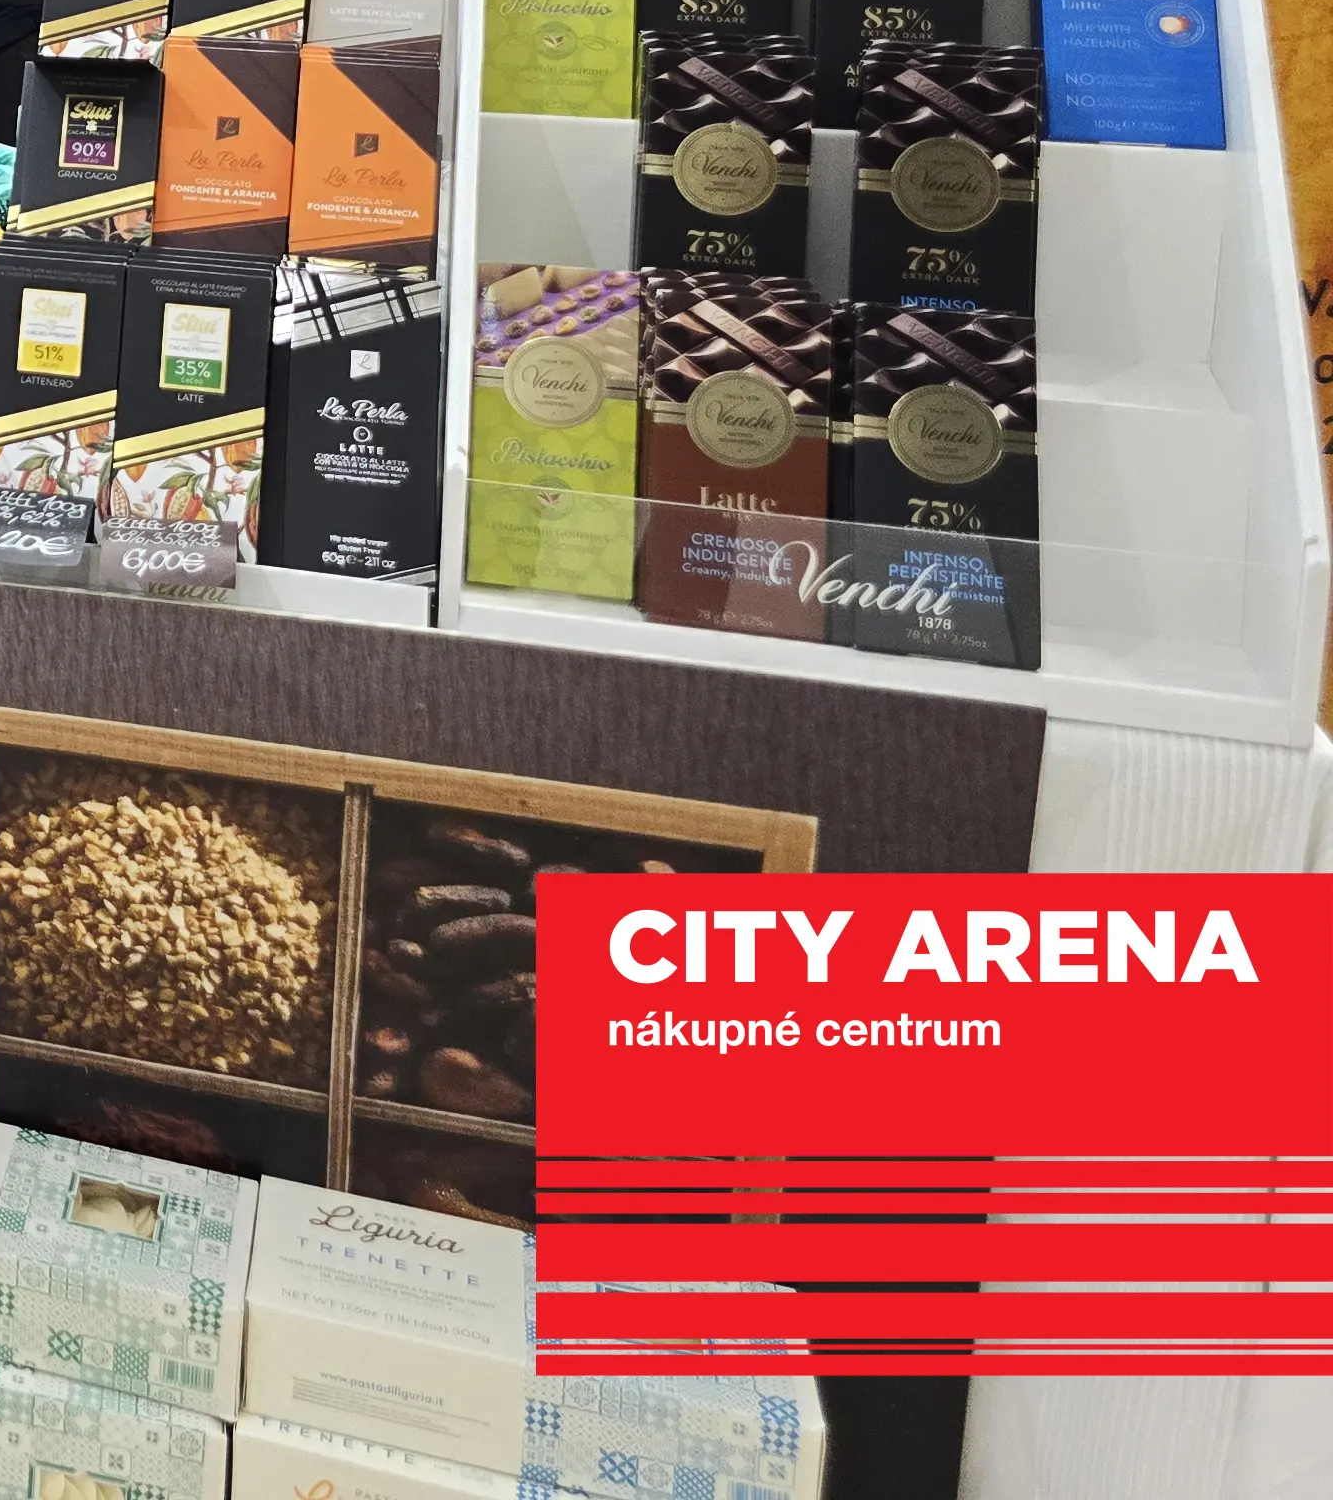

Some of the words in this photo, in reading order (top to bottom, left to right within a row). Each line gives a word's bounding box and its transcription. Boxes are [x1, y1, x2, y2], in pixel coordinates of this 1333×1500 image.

[676, 14, 715, 24] EXTRA
[718, 15, 746, 25] DARK
[863, 6, 933, 33] 85%
[860, 29, 900, 40] EXTRA
[903, 30, 934, 41] DARK
[1064, 73, 1094, 86] NO
[1066, 94, 1095, 108] NO
[71, 142, 107, 158] 90%
[57, 170, 83, 180] GRAN
[84, 171, 117, 181] CACAO
[170, 184, 222, 197] FONDENTE
[232, 188, 277, 200] ARANCIA
[307, 202, 361, 215] FONDENTE
[373, 206, 420, 219] ARANCIA
[685, 230, 753, 258] 75%
[682, 254, 723, 265] EXTRA
[726, 256, 756, 266] DARK
[905, 246, 976, 274] 75%
[901, 271, 943, 282] EXTRA
[945, 273, 981, 285] DARK
[33, 345, 64, 362] 51%
[175, 359, 211, 378] 35%
[20, 375, 74, 388] LATTENERO
[178, 393, 204, 404] LATTE
[317, 396, 348, 421] La
[352, 400, 409, 421] Perla
[339, 443, 385, 455] LATTE
[699, 485, 778, 513] Latte
[907, 498, 982, 528] 75%
[768, 540, 956, 616] Venchi
[917, 616, 952, 630] 1878
[308, 1205, 464, 1256] Liguria
[296, 1235, 480, 1288] TRENETTE
[258, 1415, 417, 1465] TRENETTE
